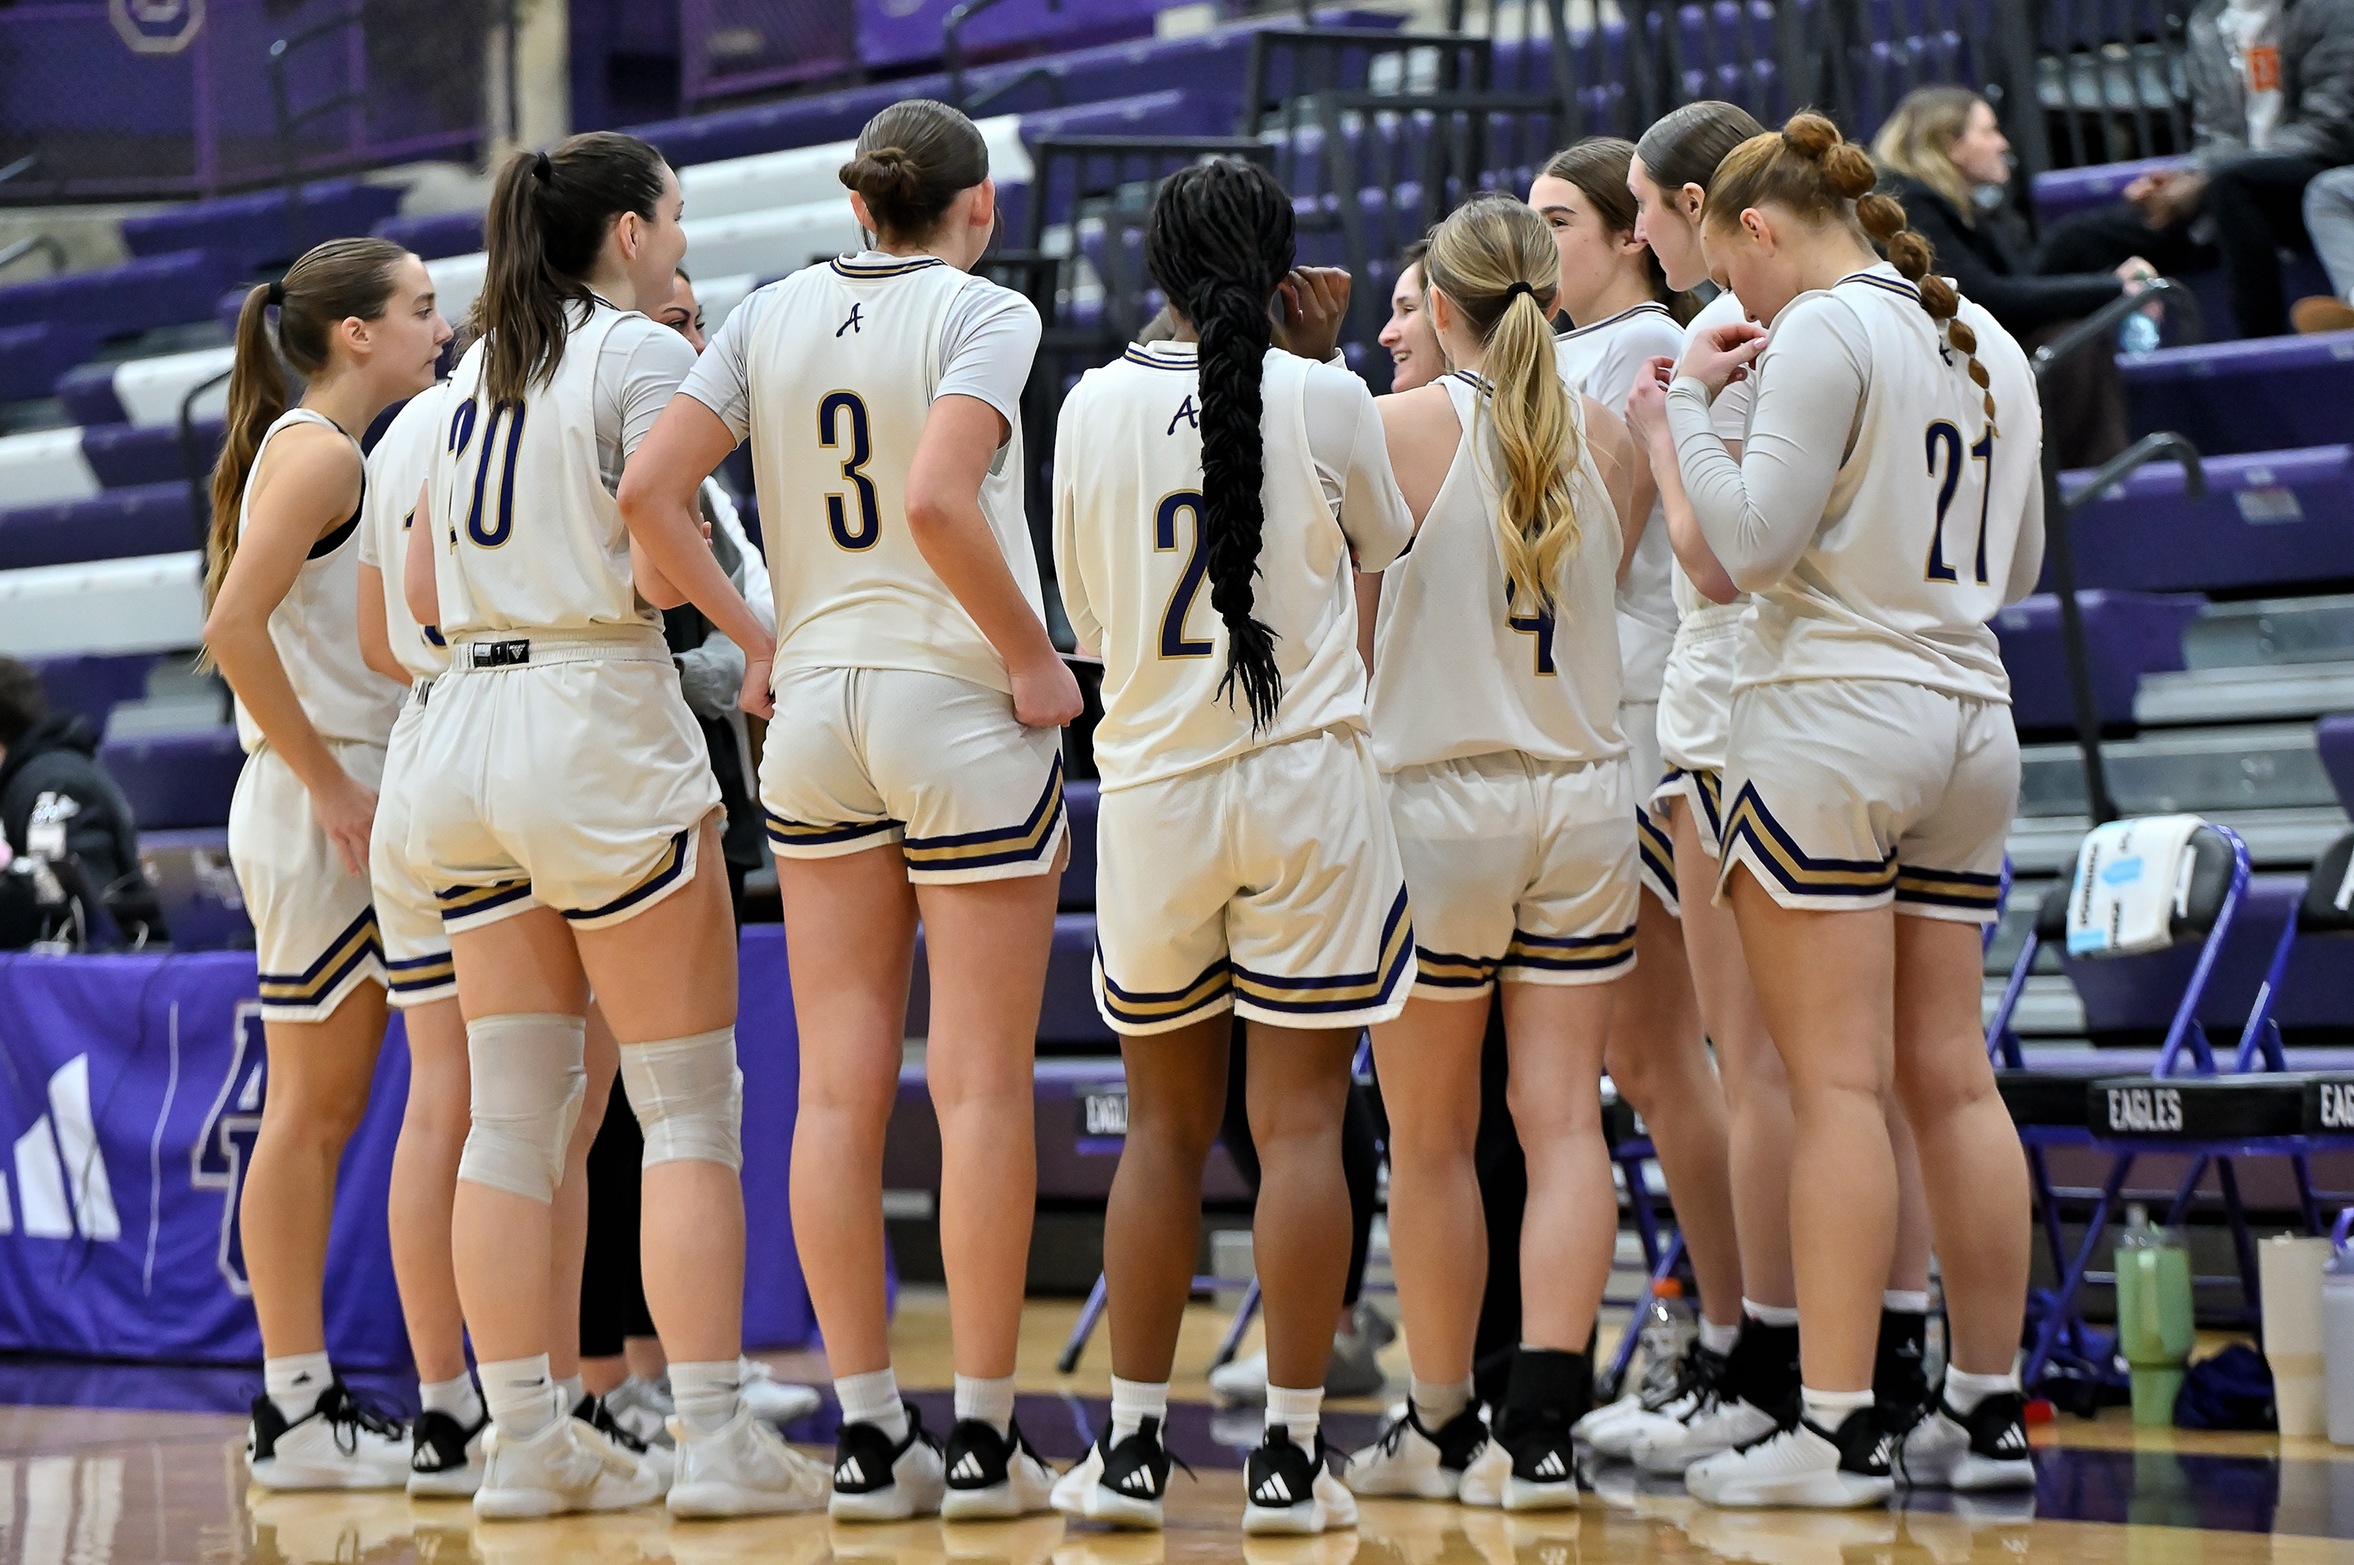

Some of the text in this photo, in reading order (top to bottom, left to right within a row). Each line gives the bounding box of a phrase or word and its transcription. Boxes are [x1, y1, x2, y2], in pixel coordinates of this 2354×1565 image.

[836, 302, 864, 338] A
[1167, 394, 1200, 436] A
[816, 388, 882, 553] 3
[1923, 418, 1990, 587] 21
[1152, 488, 1215, 661] 2
[2106, 1088, 2183, 1131] EAGLES
